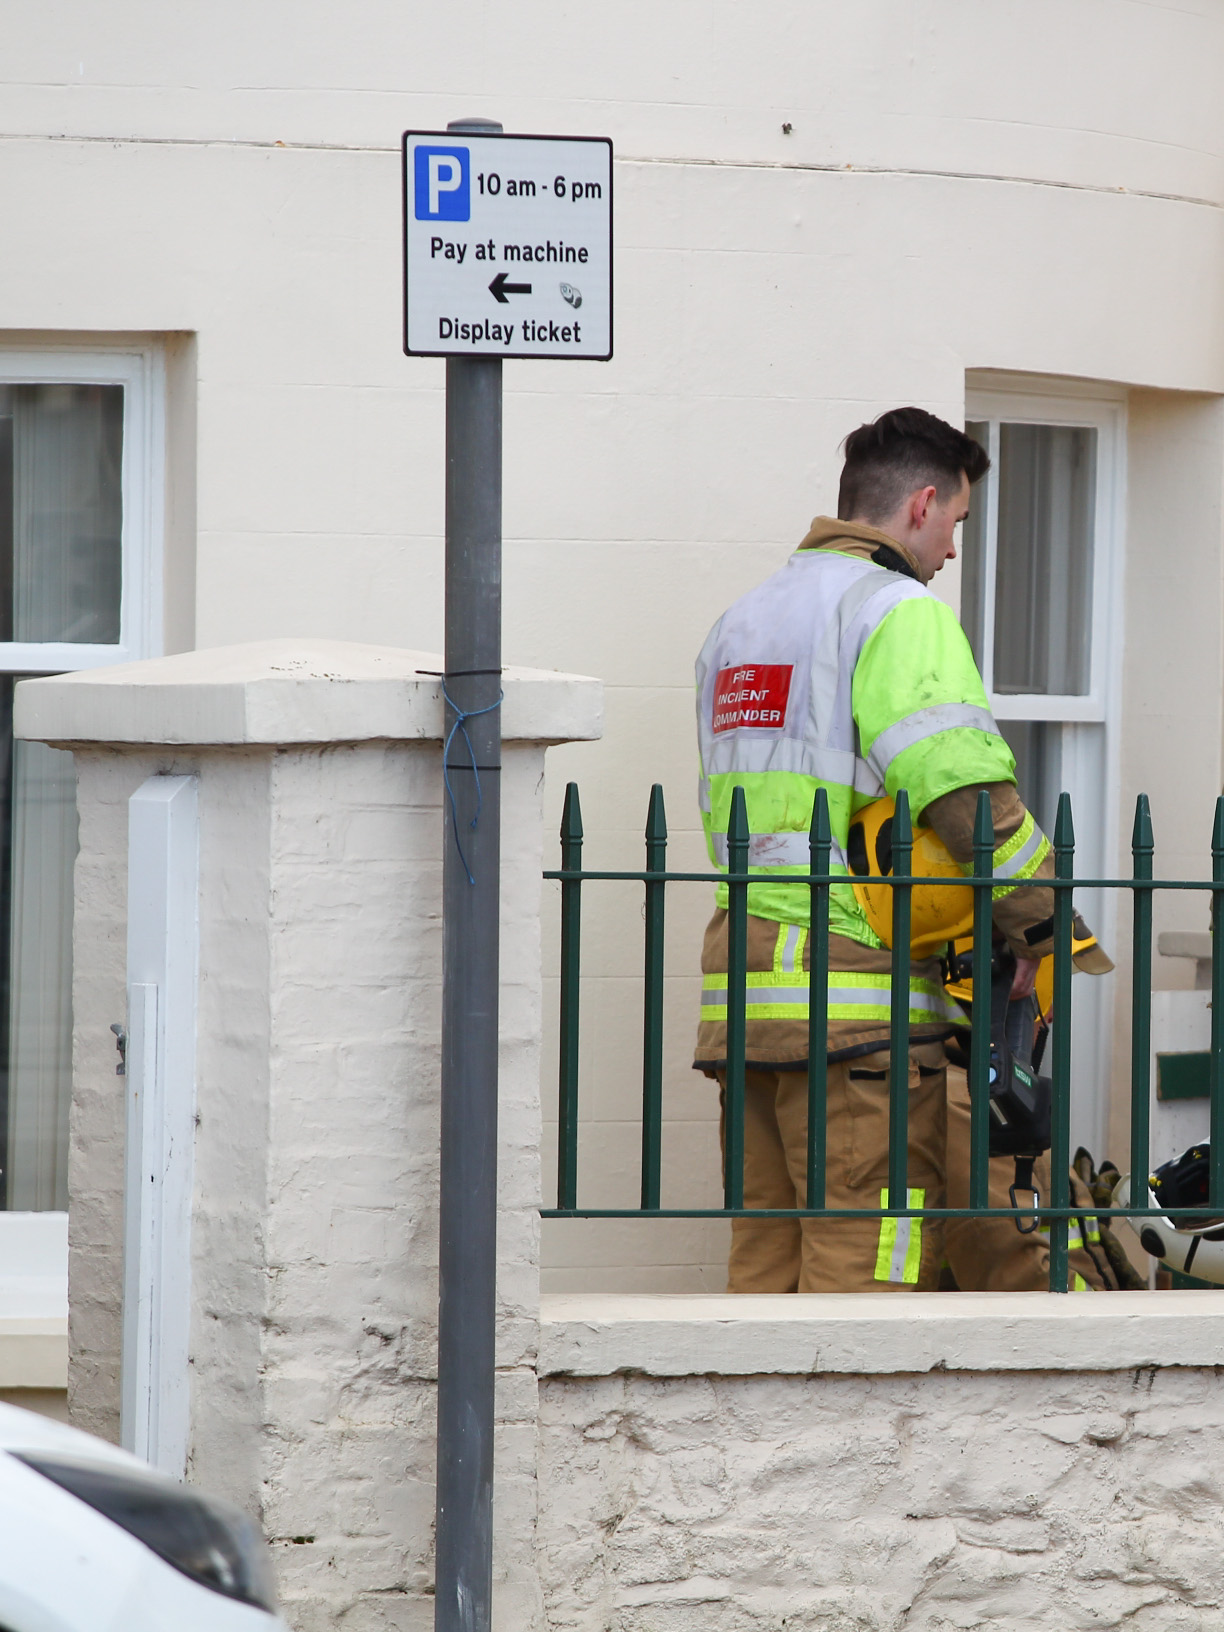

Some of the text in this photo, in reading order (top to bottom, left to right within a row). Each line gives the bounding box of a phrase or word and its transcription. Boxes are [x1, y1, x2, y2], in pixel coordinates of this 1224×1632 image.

[428, 154, 462, 214] P
[477, 172, 501, 195] 10
[507, 179, 536, 197] am
[553, 175, 566, 198] 6
[571, 183, 602, 202] pm
[430, 236, 589, 264] Pay at machine
[439, 317, 581, 345] Display ticket
[732, 669, 756, 684] FRE
[713, 709, 781, 728] COMMNDER
